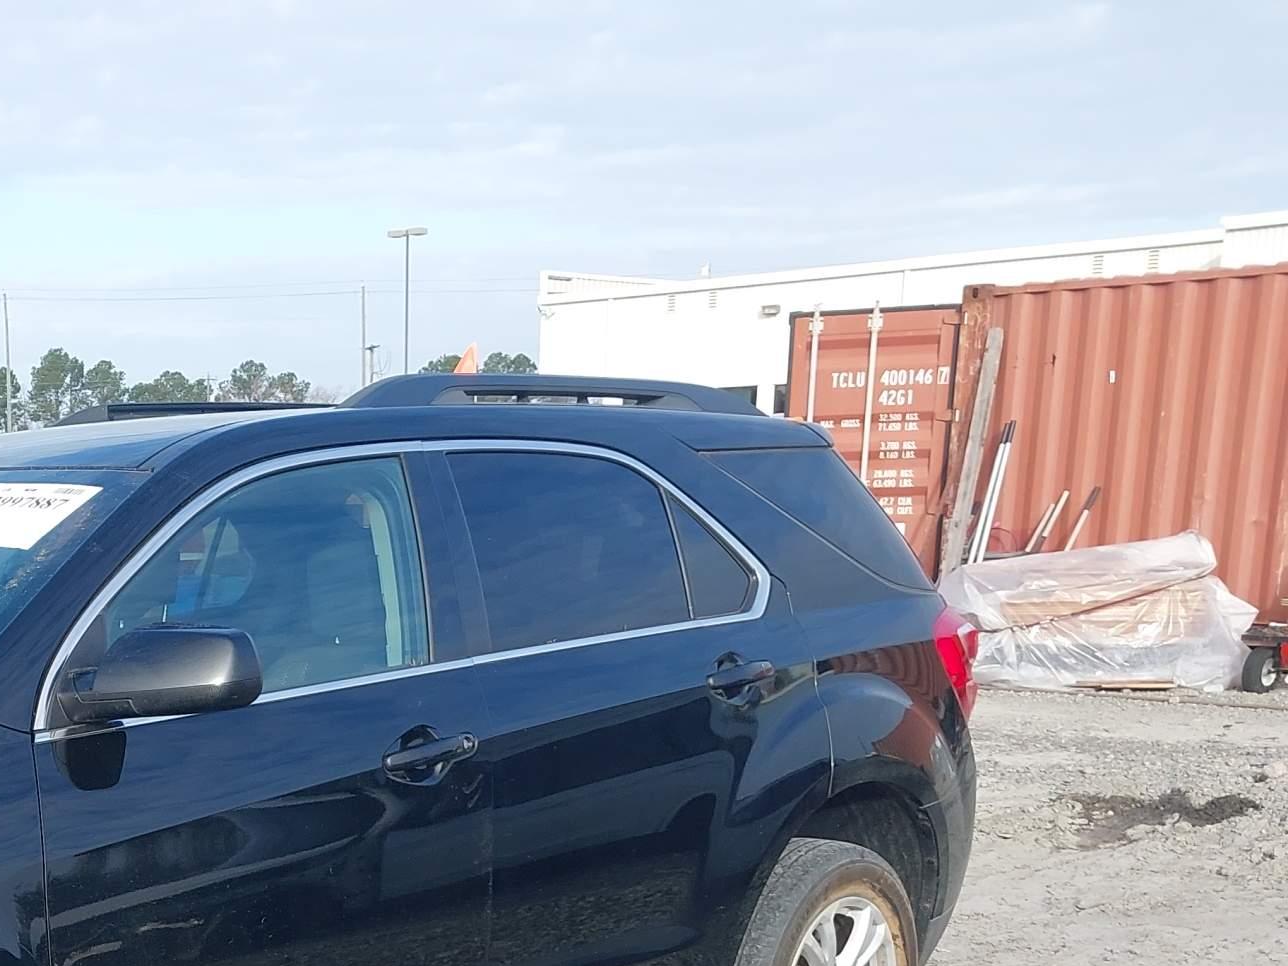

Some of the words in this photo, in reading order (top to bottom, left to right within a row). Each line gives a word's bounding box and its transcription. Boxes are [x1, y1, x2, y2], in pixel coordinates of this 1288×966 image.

[831, 371, 866, 388] TCLU
[880, 368, 934, 386] 400146
[938, 367, 950, 385] 7
